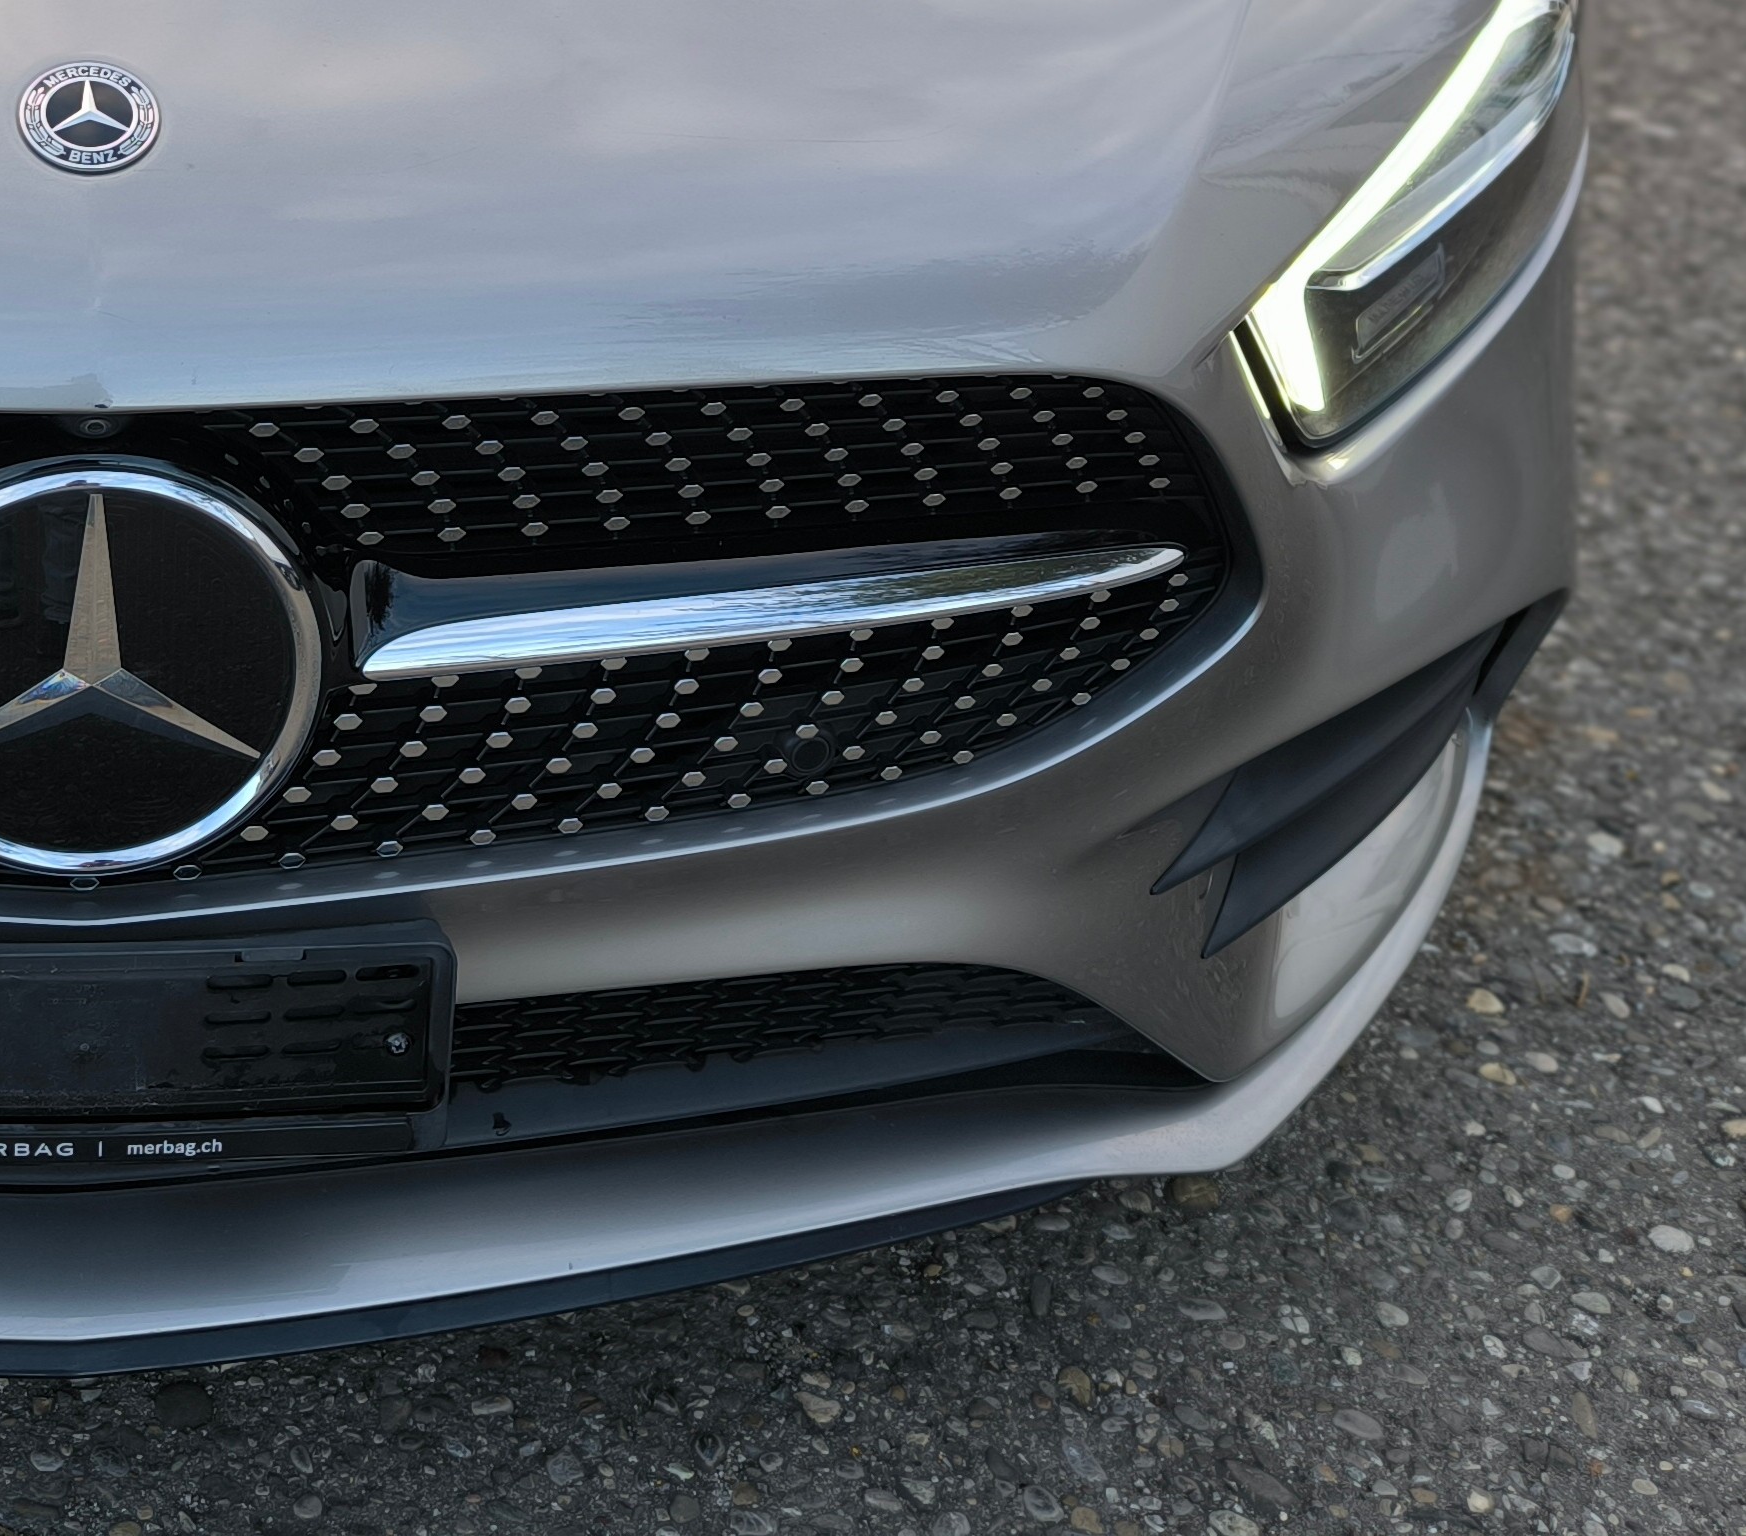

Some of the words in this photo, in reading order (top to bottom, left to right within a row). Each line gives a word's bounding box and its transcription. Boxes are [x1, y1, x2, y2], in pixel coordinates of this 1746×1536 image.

[43, 66, 132, 88] MERCEDES
[68, 149, 118, 164] BENZ
[126, 1138, 224, 1157] merbag.ch
